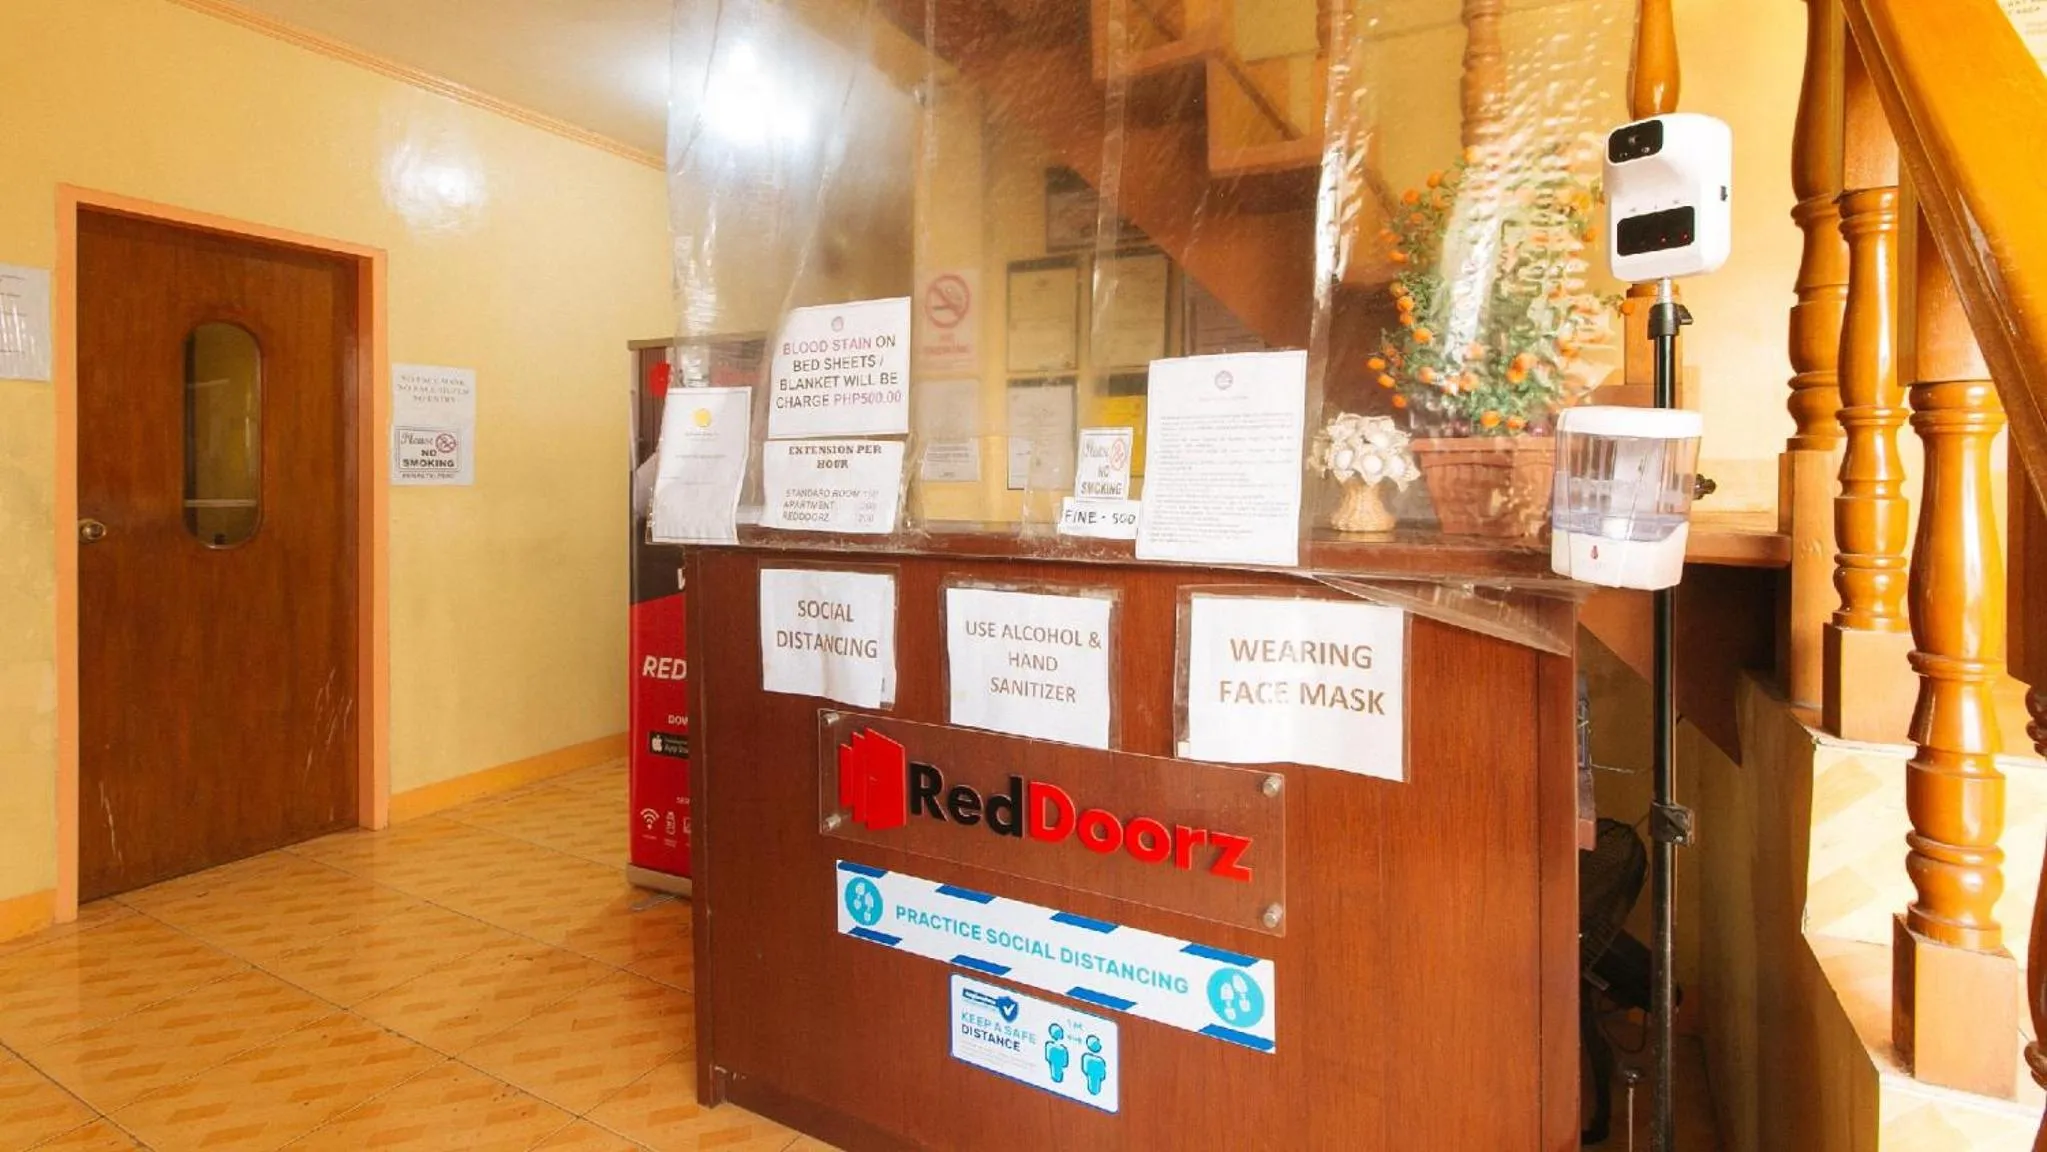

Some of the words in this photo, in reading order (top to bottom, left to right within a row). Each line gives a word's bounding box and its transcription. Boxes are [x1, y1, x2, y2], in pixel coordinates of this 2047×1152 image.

[783, 340, 829, 355] BLOOD
[832, 337, 872, 351] STAIN
[875, 335, 896, 348] ON
[793, 359, 820, 372] BED
[824, 355, 876, 370] SHEETS
[780, 376, 840, 391] BLANKET
[843, 374, 875, 387] WILL
[880, 372, 898, 384] BE
[776, 394, 829, 409] CHARGE
[834, 390, 902, 406] PHP500.00
[421, 449, 437, 457] NO
[788, 445, 854, 455] EXTENSION
[856, 445, 882, 454] PER
[402, 459, 455, 468] SMOKING
[817, 459, 849, 469] HOUR
[1098, 464, 1109, 478] NO
[786, 488, 831, 498] STANDARD
[1080, 481, 1122, 495] SMOKING
[783, 500, 835, 510] APARTMENT
[1065, 509, 1097, 524] FINE
[1112, 512, 1137, 525] 500
[797, 599, 854, 623] SOCIAL
[965, 620, 997, 639] USE
[1002, 624, 1083, 647] ALCOHOL
[1088, 630, 1102, 649] &
[776, 630, 878, 659] DISTANCING
[1230, 638, 1373, 670] WEARING
[642, 655, 688, 680] RED
[1008, 653, 1058, 672] HAND
[990, 677, 1076, 703] SANITIZER
[1219, 680, 1289, 704] FACE
[1300, 682, 1386, 716] MASK
[910, 761, 1254, 883] RedDoorz
[895, 905, 983, 943] PRACTICE
[986, 927, 1057, 960] SOCIAL
[1060, 946, 1190, 995] DISTANCING
[961, 1012, 992, 1029] KEEP
[994, 1022, 1002, 1033] A
[1004, 1025, 1038, 1045] SAFE
[961, 1024, 1021, 1052] DISTANCE
